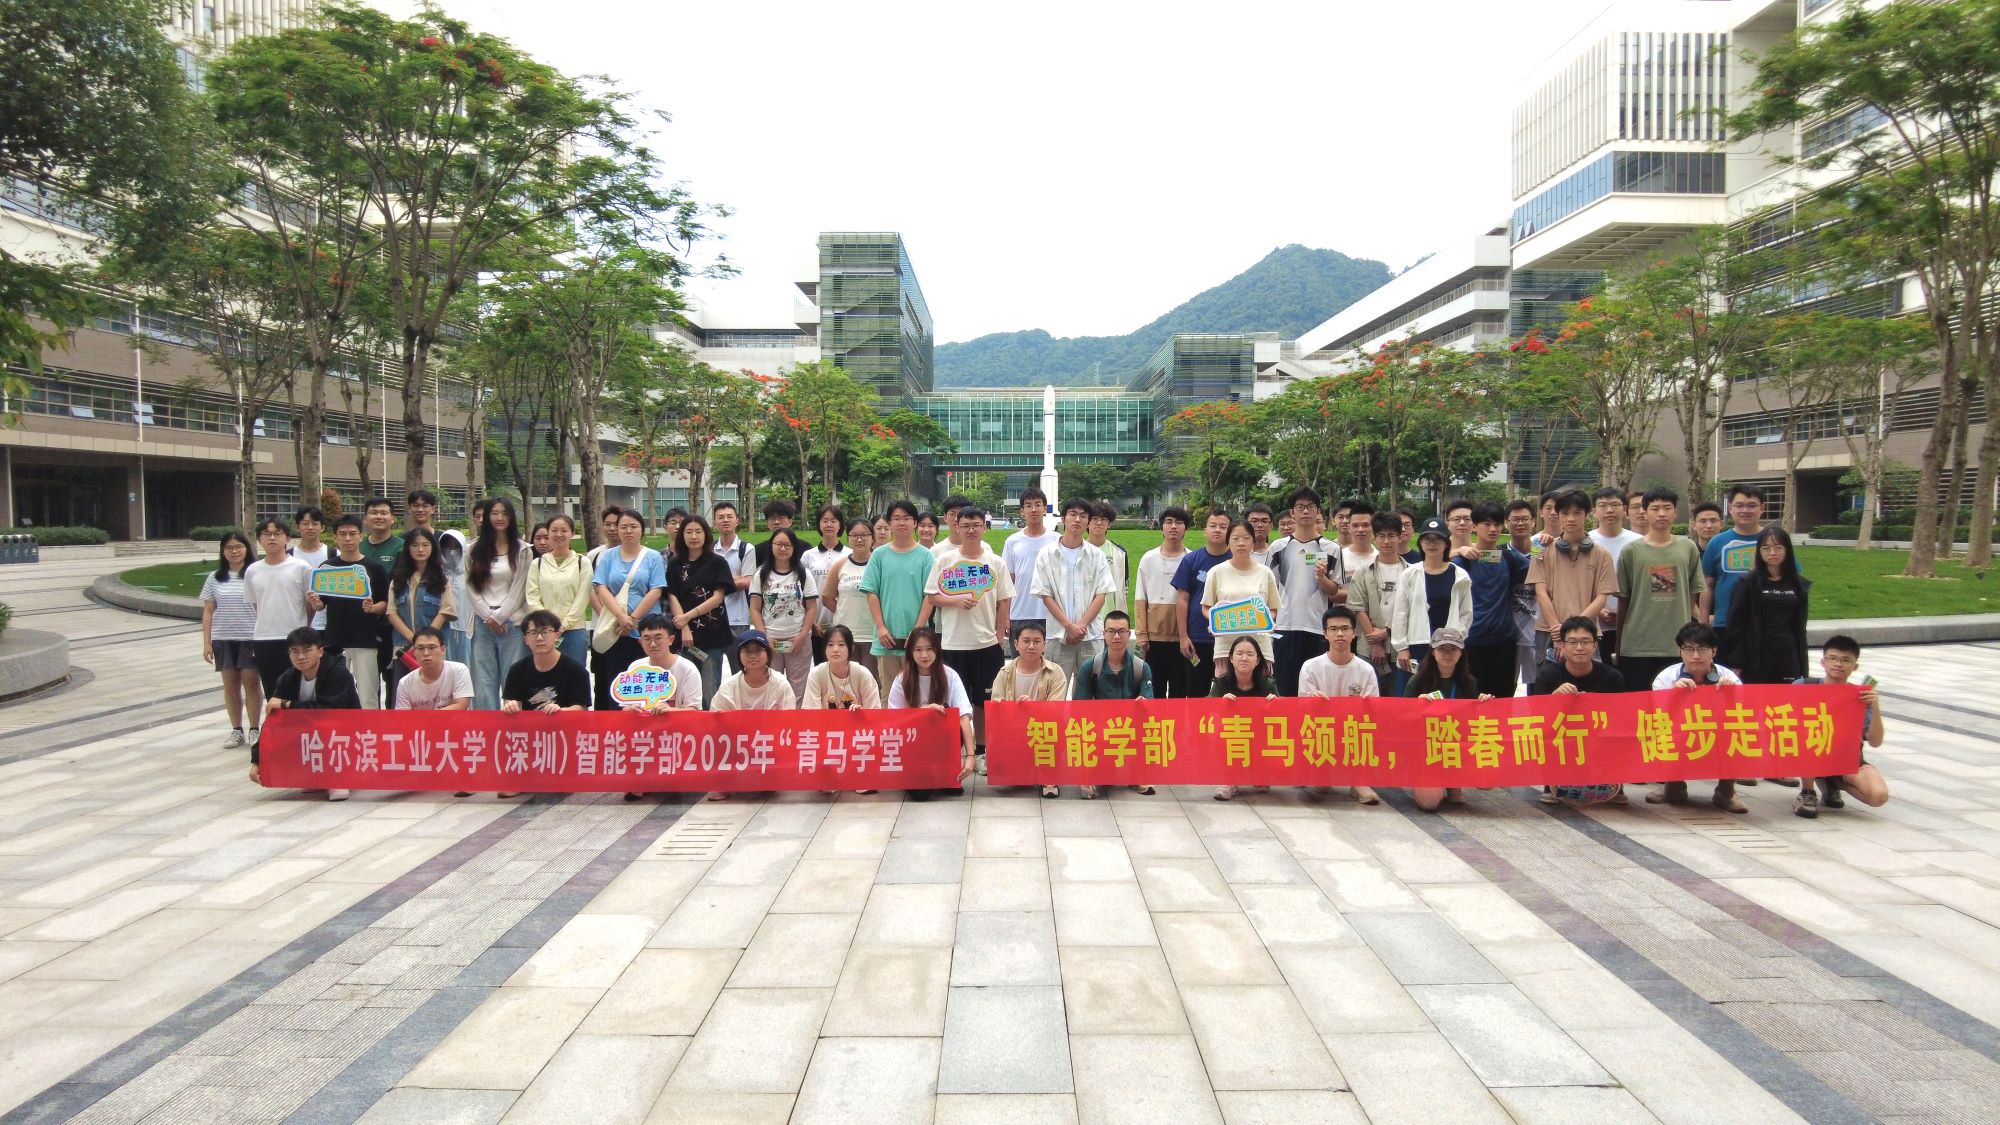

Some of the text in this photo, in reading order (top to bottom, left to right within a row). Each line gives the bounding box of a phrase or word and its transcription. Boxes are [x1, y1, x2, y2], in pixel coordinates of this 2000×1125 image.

[942, 565, 990, 579] 动能无限
[620, 671, 670, 684] 动能无限
[301, 728, 917, 775] 哈尔滨工业大学(深圳)智能学部2025年“青马学堂”
